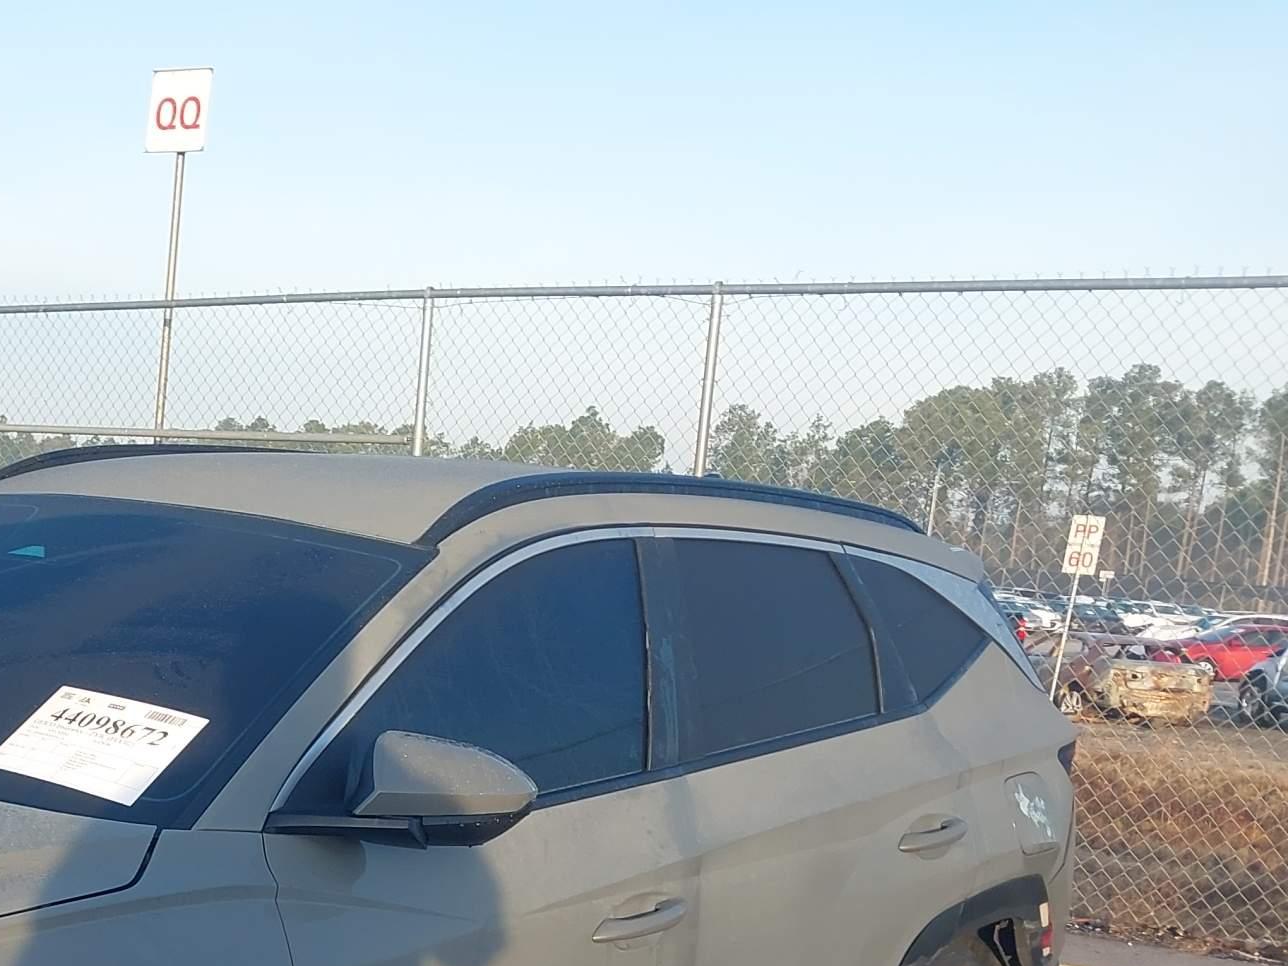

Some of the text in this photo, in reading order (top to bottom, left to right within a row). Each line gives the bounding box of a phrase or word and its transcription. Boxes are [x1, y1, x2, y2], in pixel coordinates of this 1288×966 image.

[156, 96, 201, 130] QQ
[1075, 523, 1099, 539] PP
[1068, 551, 1093, 568] 60
[51, 707, 169, 746] 44098672
